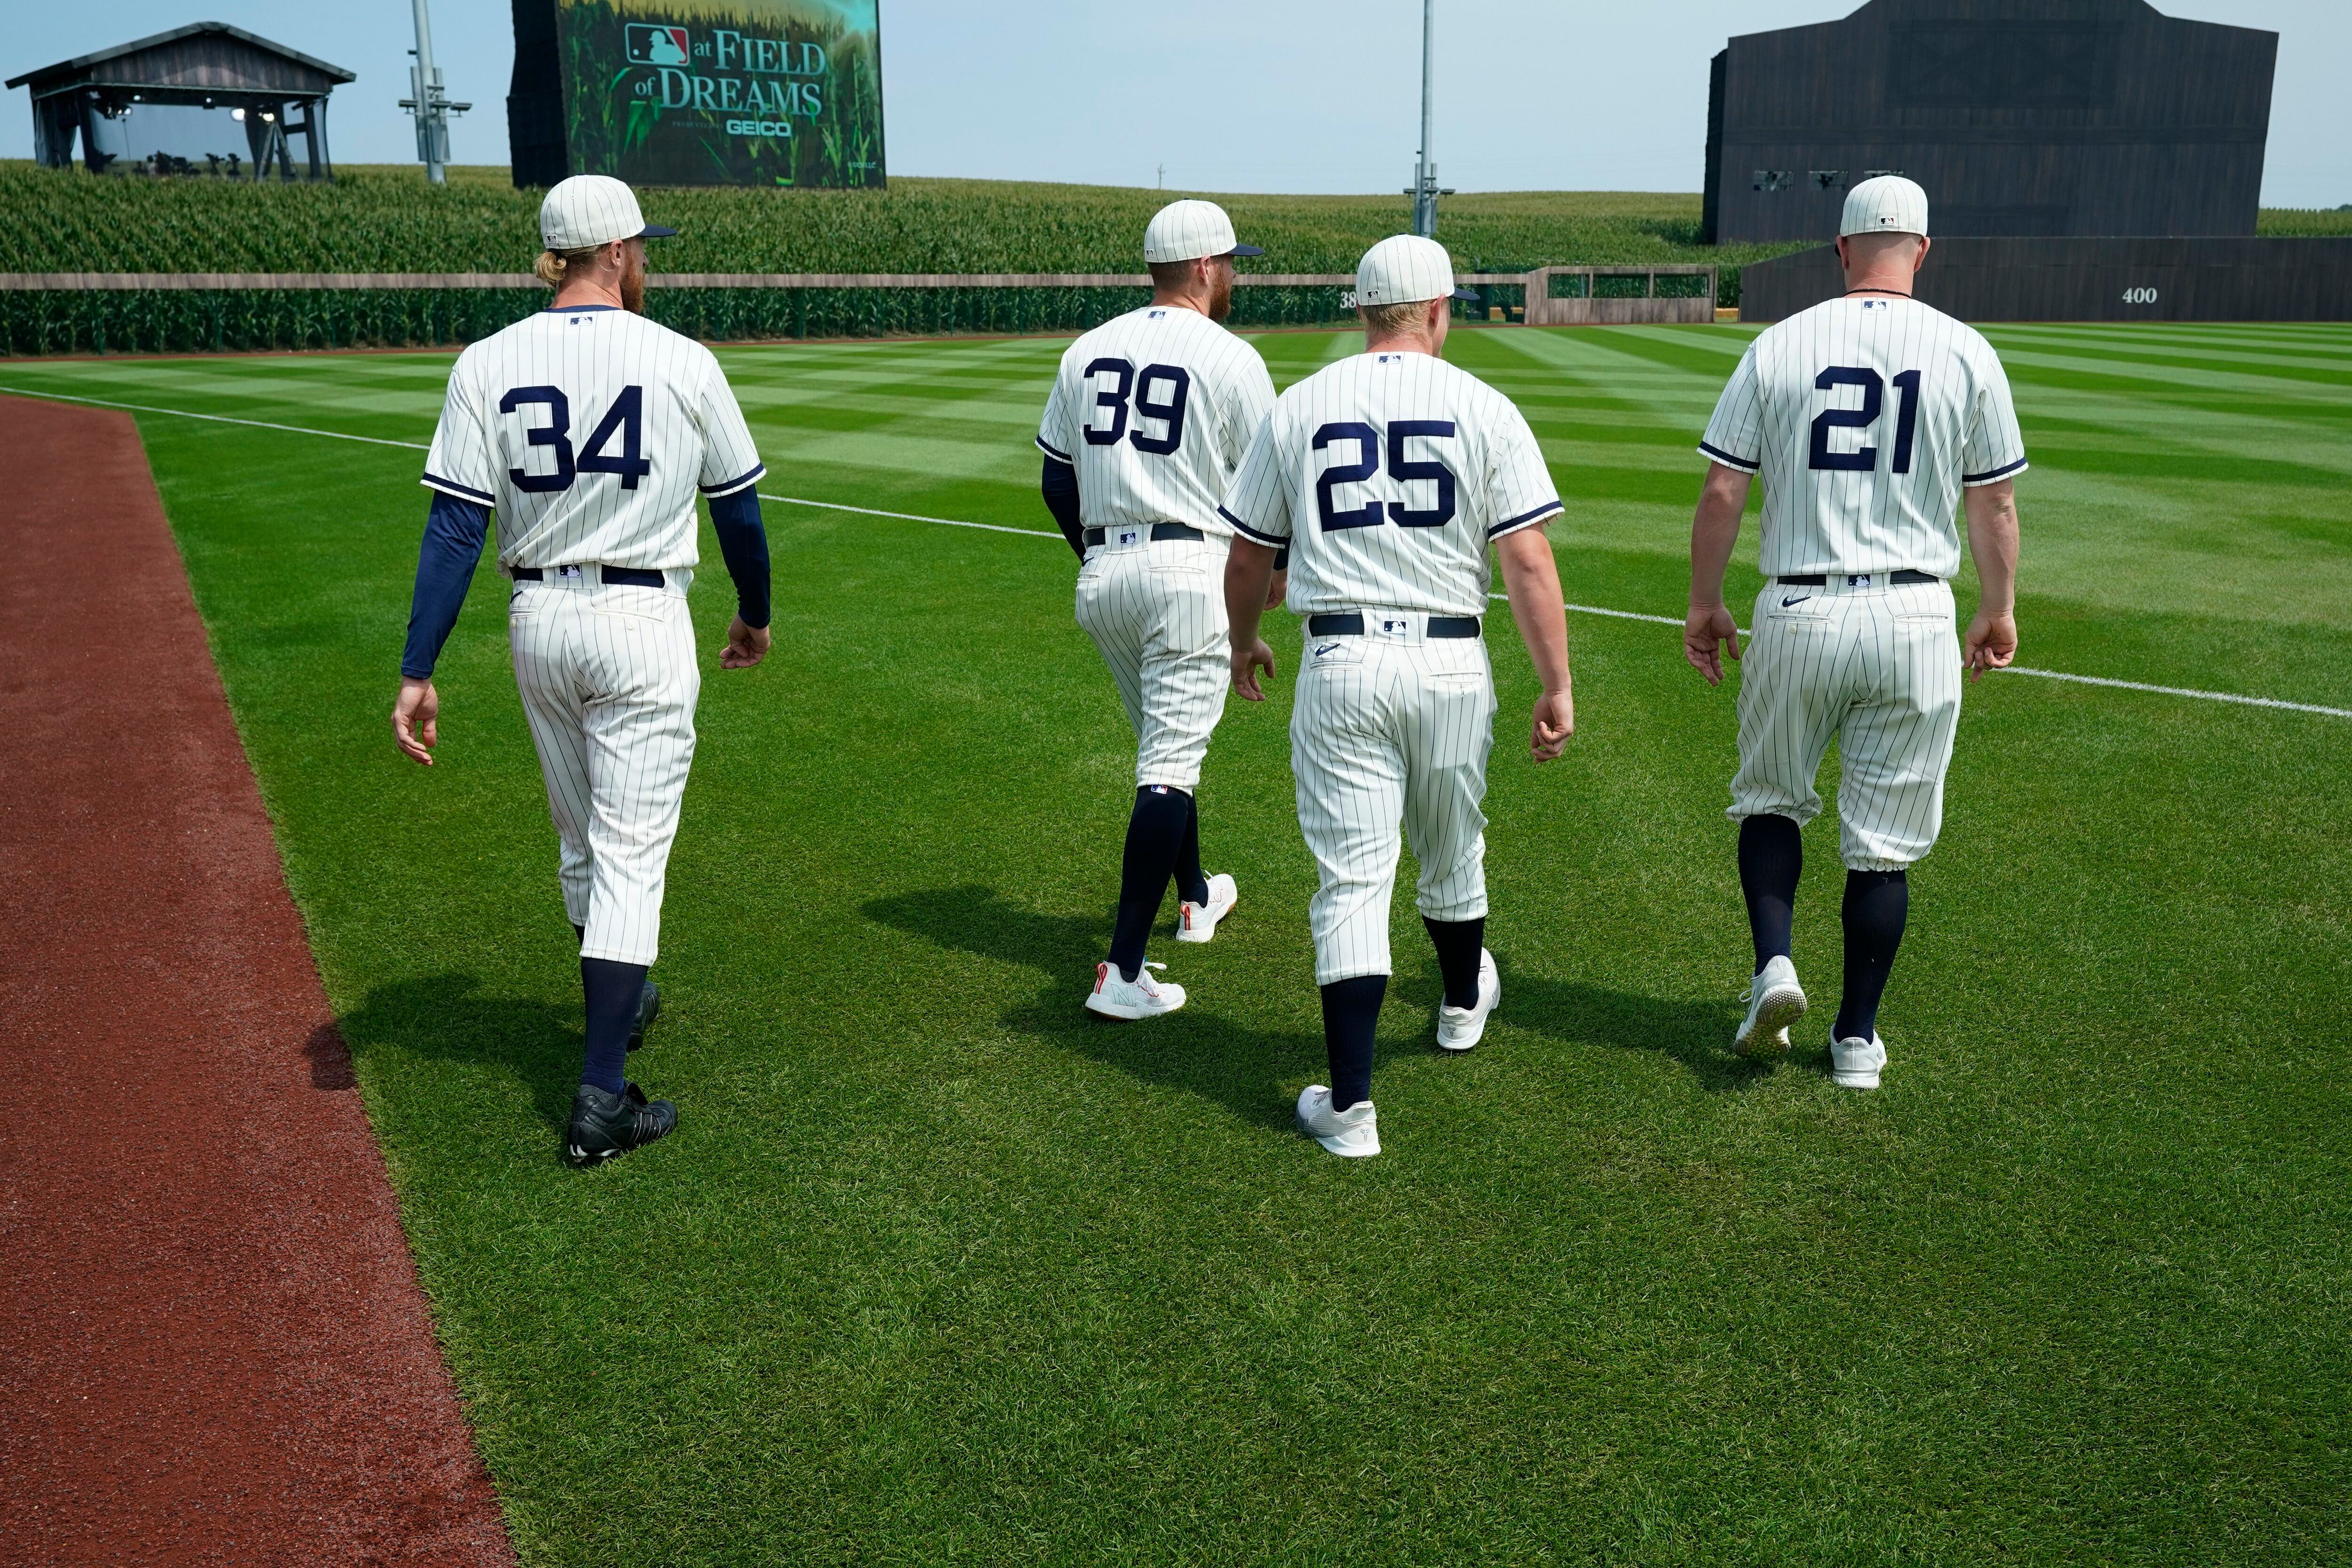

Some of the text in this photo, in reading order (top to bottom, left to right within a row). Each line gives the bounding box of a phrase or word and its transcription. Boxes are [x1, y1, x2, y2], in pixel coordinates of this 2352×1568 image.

[694, 29, 826, 76] at FIELD
[635, 67, 822, 116] of DREAMS
[726, 119, 791, 137] GEICO
[2122, 287, 2157, 303] 400
[1084, 357, 1190, 455] 39
[1809, 366, 1921, 473] 21
[500, 385, 650, 492] 34
[1312, 420, 1455, 531] 25
[1111, 984, 1136, 1007] N
